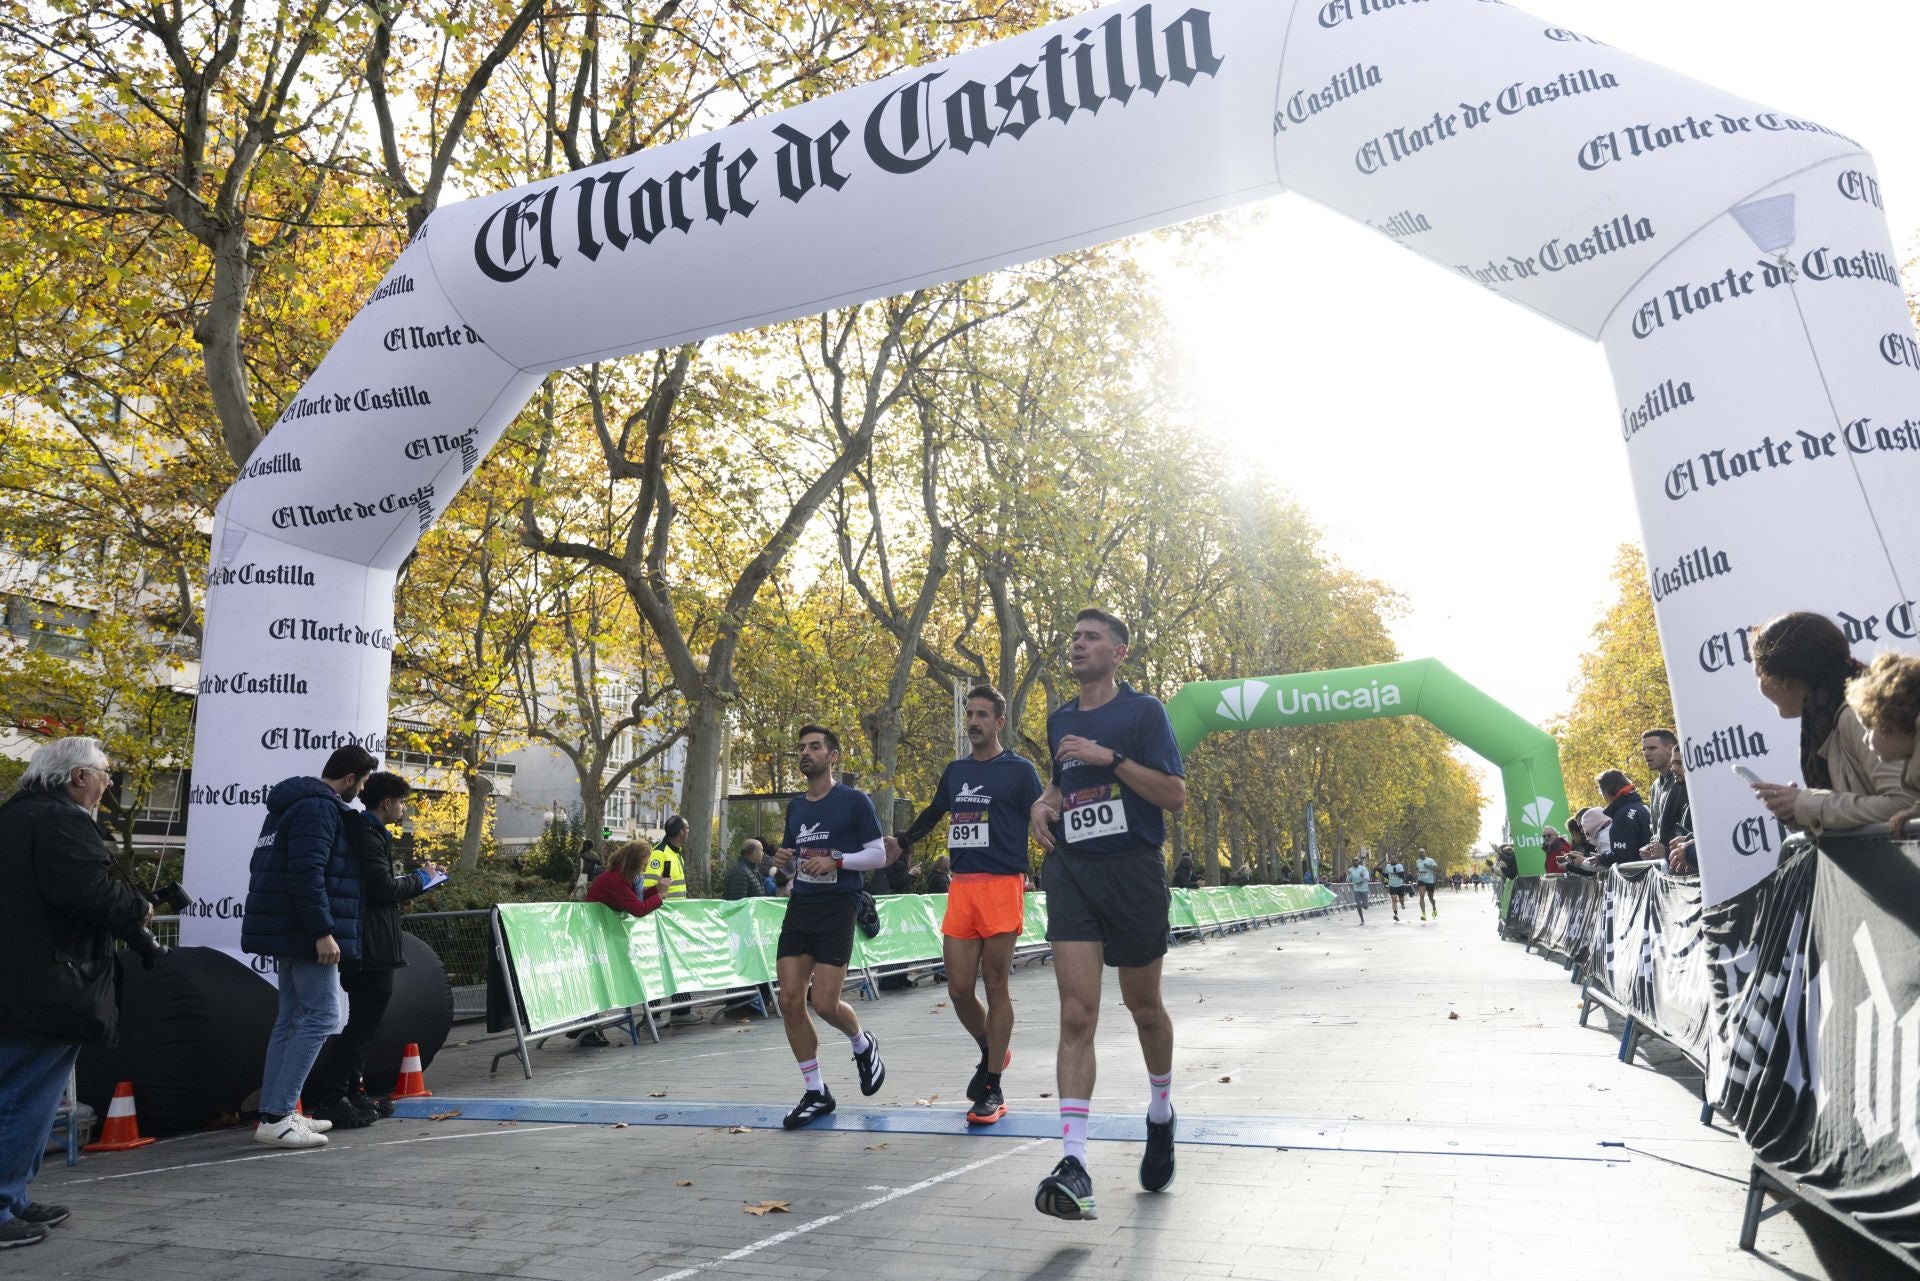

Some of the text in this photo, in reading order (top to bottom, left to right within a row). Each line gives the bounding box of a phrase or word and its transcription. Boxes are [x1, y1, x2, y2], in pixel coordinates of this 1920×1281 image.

[1287, 62, 1383, 124] Castilla
[1355, 68, 1621, 175] El Norte de Castilla
[474, 3, 1226, 283] El Norte de Castilla
[1577, 131, 1622, 171] El
[1622, 116, 1715, 156] Norte
[1715, 113, 1753, 135] de
[1837, 169, 1868, 203] El
[1507, 256, 1539, 279] de
[1539, 214, 1656, 272] Castilla
[1632, 297, 1665, 340] El
[1663, 268, 1755, 321] Norte
[1802, 247, 1901, 288] Castilla
[384, 327, 408, 351] El
[408, 324, 463, 351] Norte
[1880, 333, 1911, 367] El
[299, 394, 332, 419] Norte
[334, 392, 352, 412] de
[354, 385, 431, 412] Castilla
[1622, 378, 1696, 443] Castilla
[250, 451, 302, 479] Castilla
[404, 437, 432, 460] El
[1665, 458, 1700, 500] El
[1697, 436, 1795, 487] Norte
[1796, 429, 1837, 461] de
[272, 505, 298, 529] El
[298, 503, 353, 527] Norte
[353, 501, 376, 519] de
[222, 565, 237, 586] de
[238, 562, 317, 587] Castilla
[1652, 546, 1733, 603] Castilla
[269, 618, 295, 640] El
[299, 618, 353, 645] Norte
[354, 624, 370, 647] de
[1699, 632, 1736, 673] El
[1837, 610, 1881, 645] de
[214, 674, 229, 694] de
[231, 672, 308, 695] Castilla
[1277, 679, 1401, 716] Unicaja
[261, 727, 288, 750] El
[292, 727, 346, 750] Norte
[1683, 723, 1770, 773] Castilla
[206, 784, 220, 805] de
[955, 796, 991, 804] MICHELIN
[952, 825, 979, 840] 691
[1071, 804, 1114, 831] 690
[795, 833, 829, 844] MICHELIN
[1613, 841, 1626, 849] HH
[1732, 815, 1772, 857] El
[199, 897, 214, 918] de
